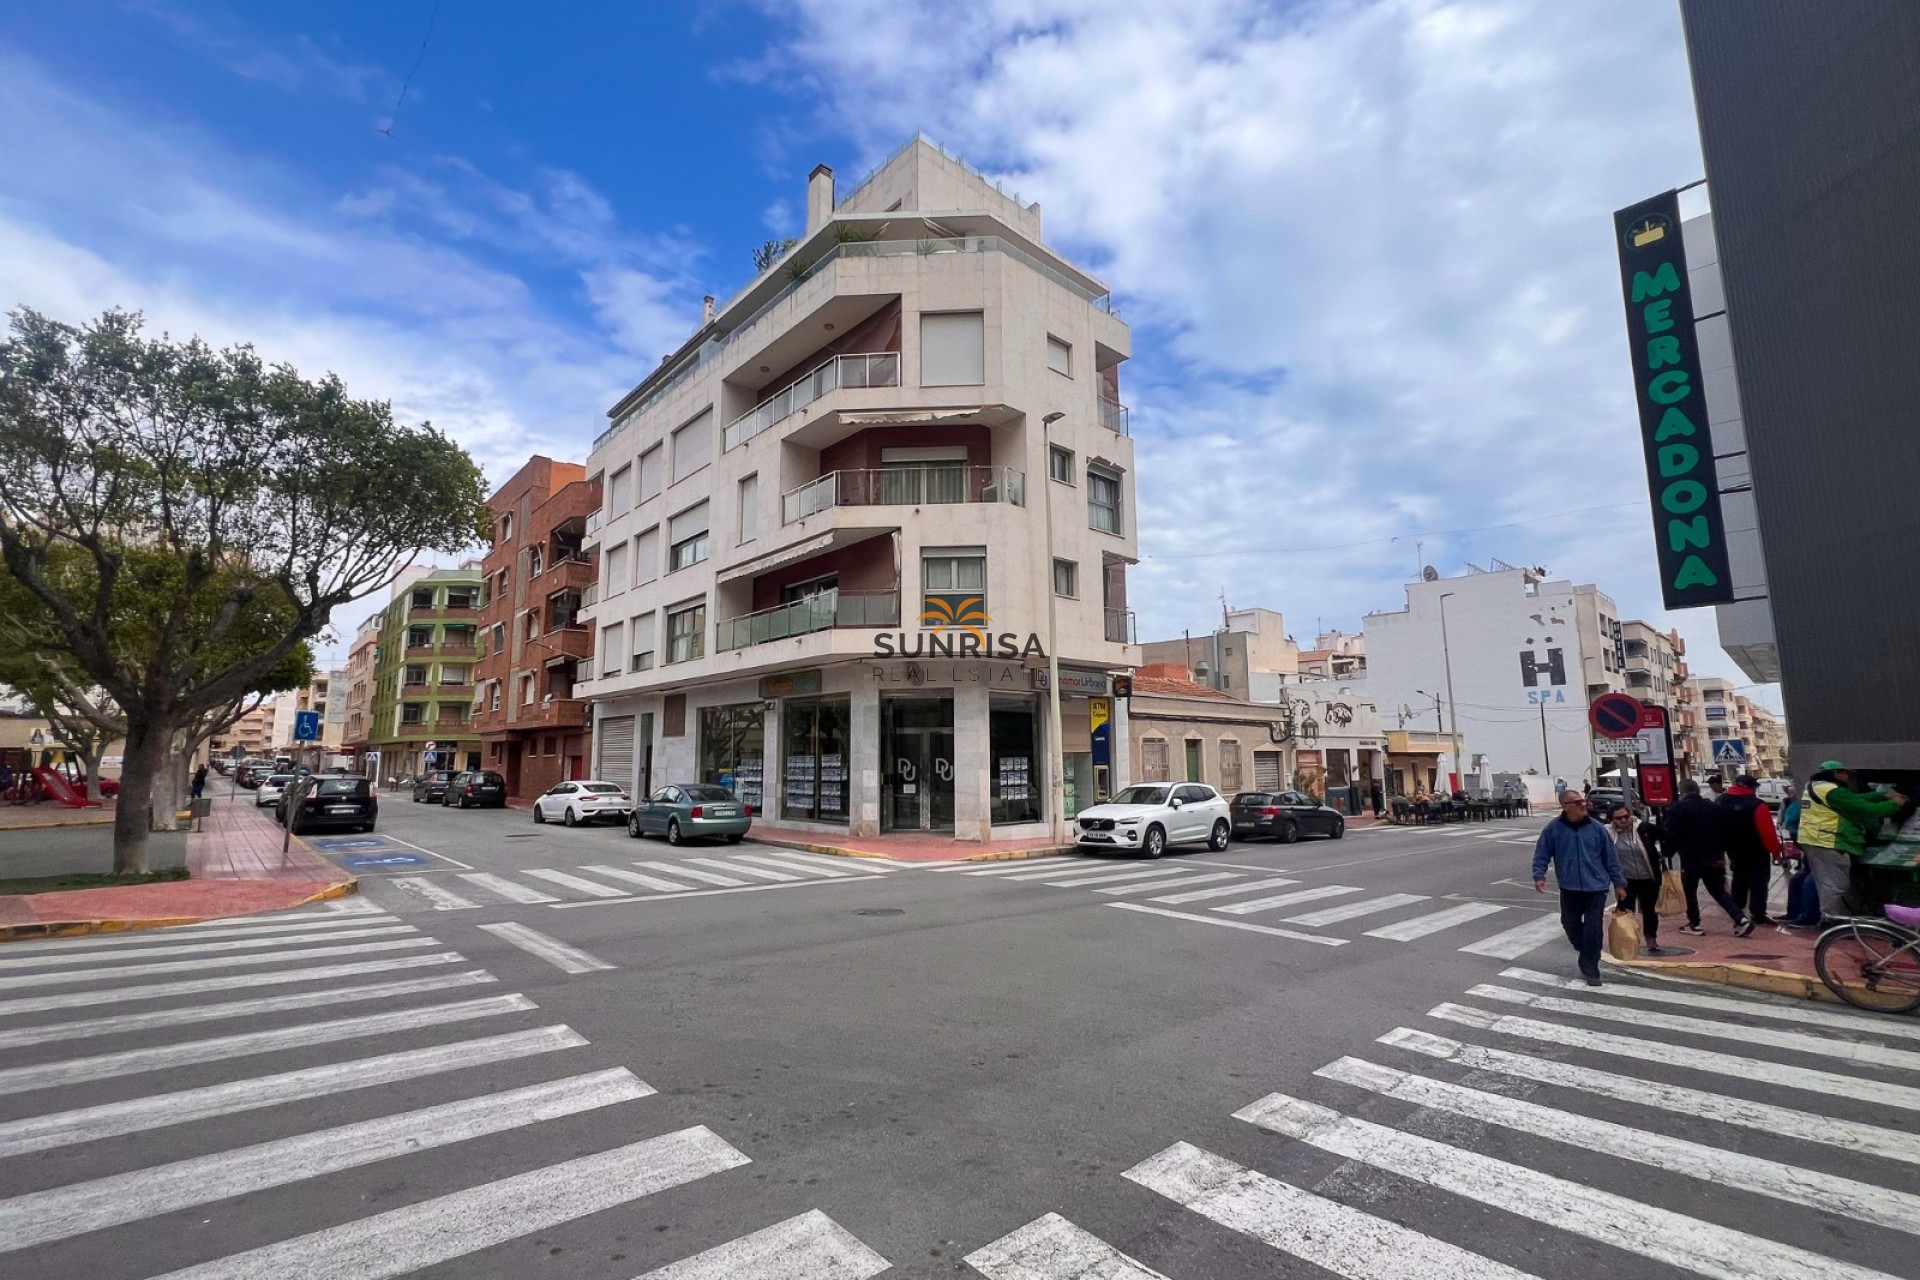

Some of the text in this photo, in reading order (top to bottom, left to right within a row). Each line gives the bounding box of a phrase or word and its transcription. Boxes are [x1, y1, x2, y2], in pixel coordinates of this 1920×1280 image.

[1631, 262, 1718, 590] MERCADONA
[1519, 648, 1566, 687] H
[1528, 690, 1566, 704] SPA
